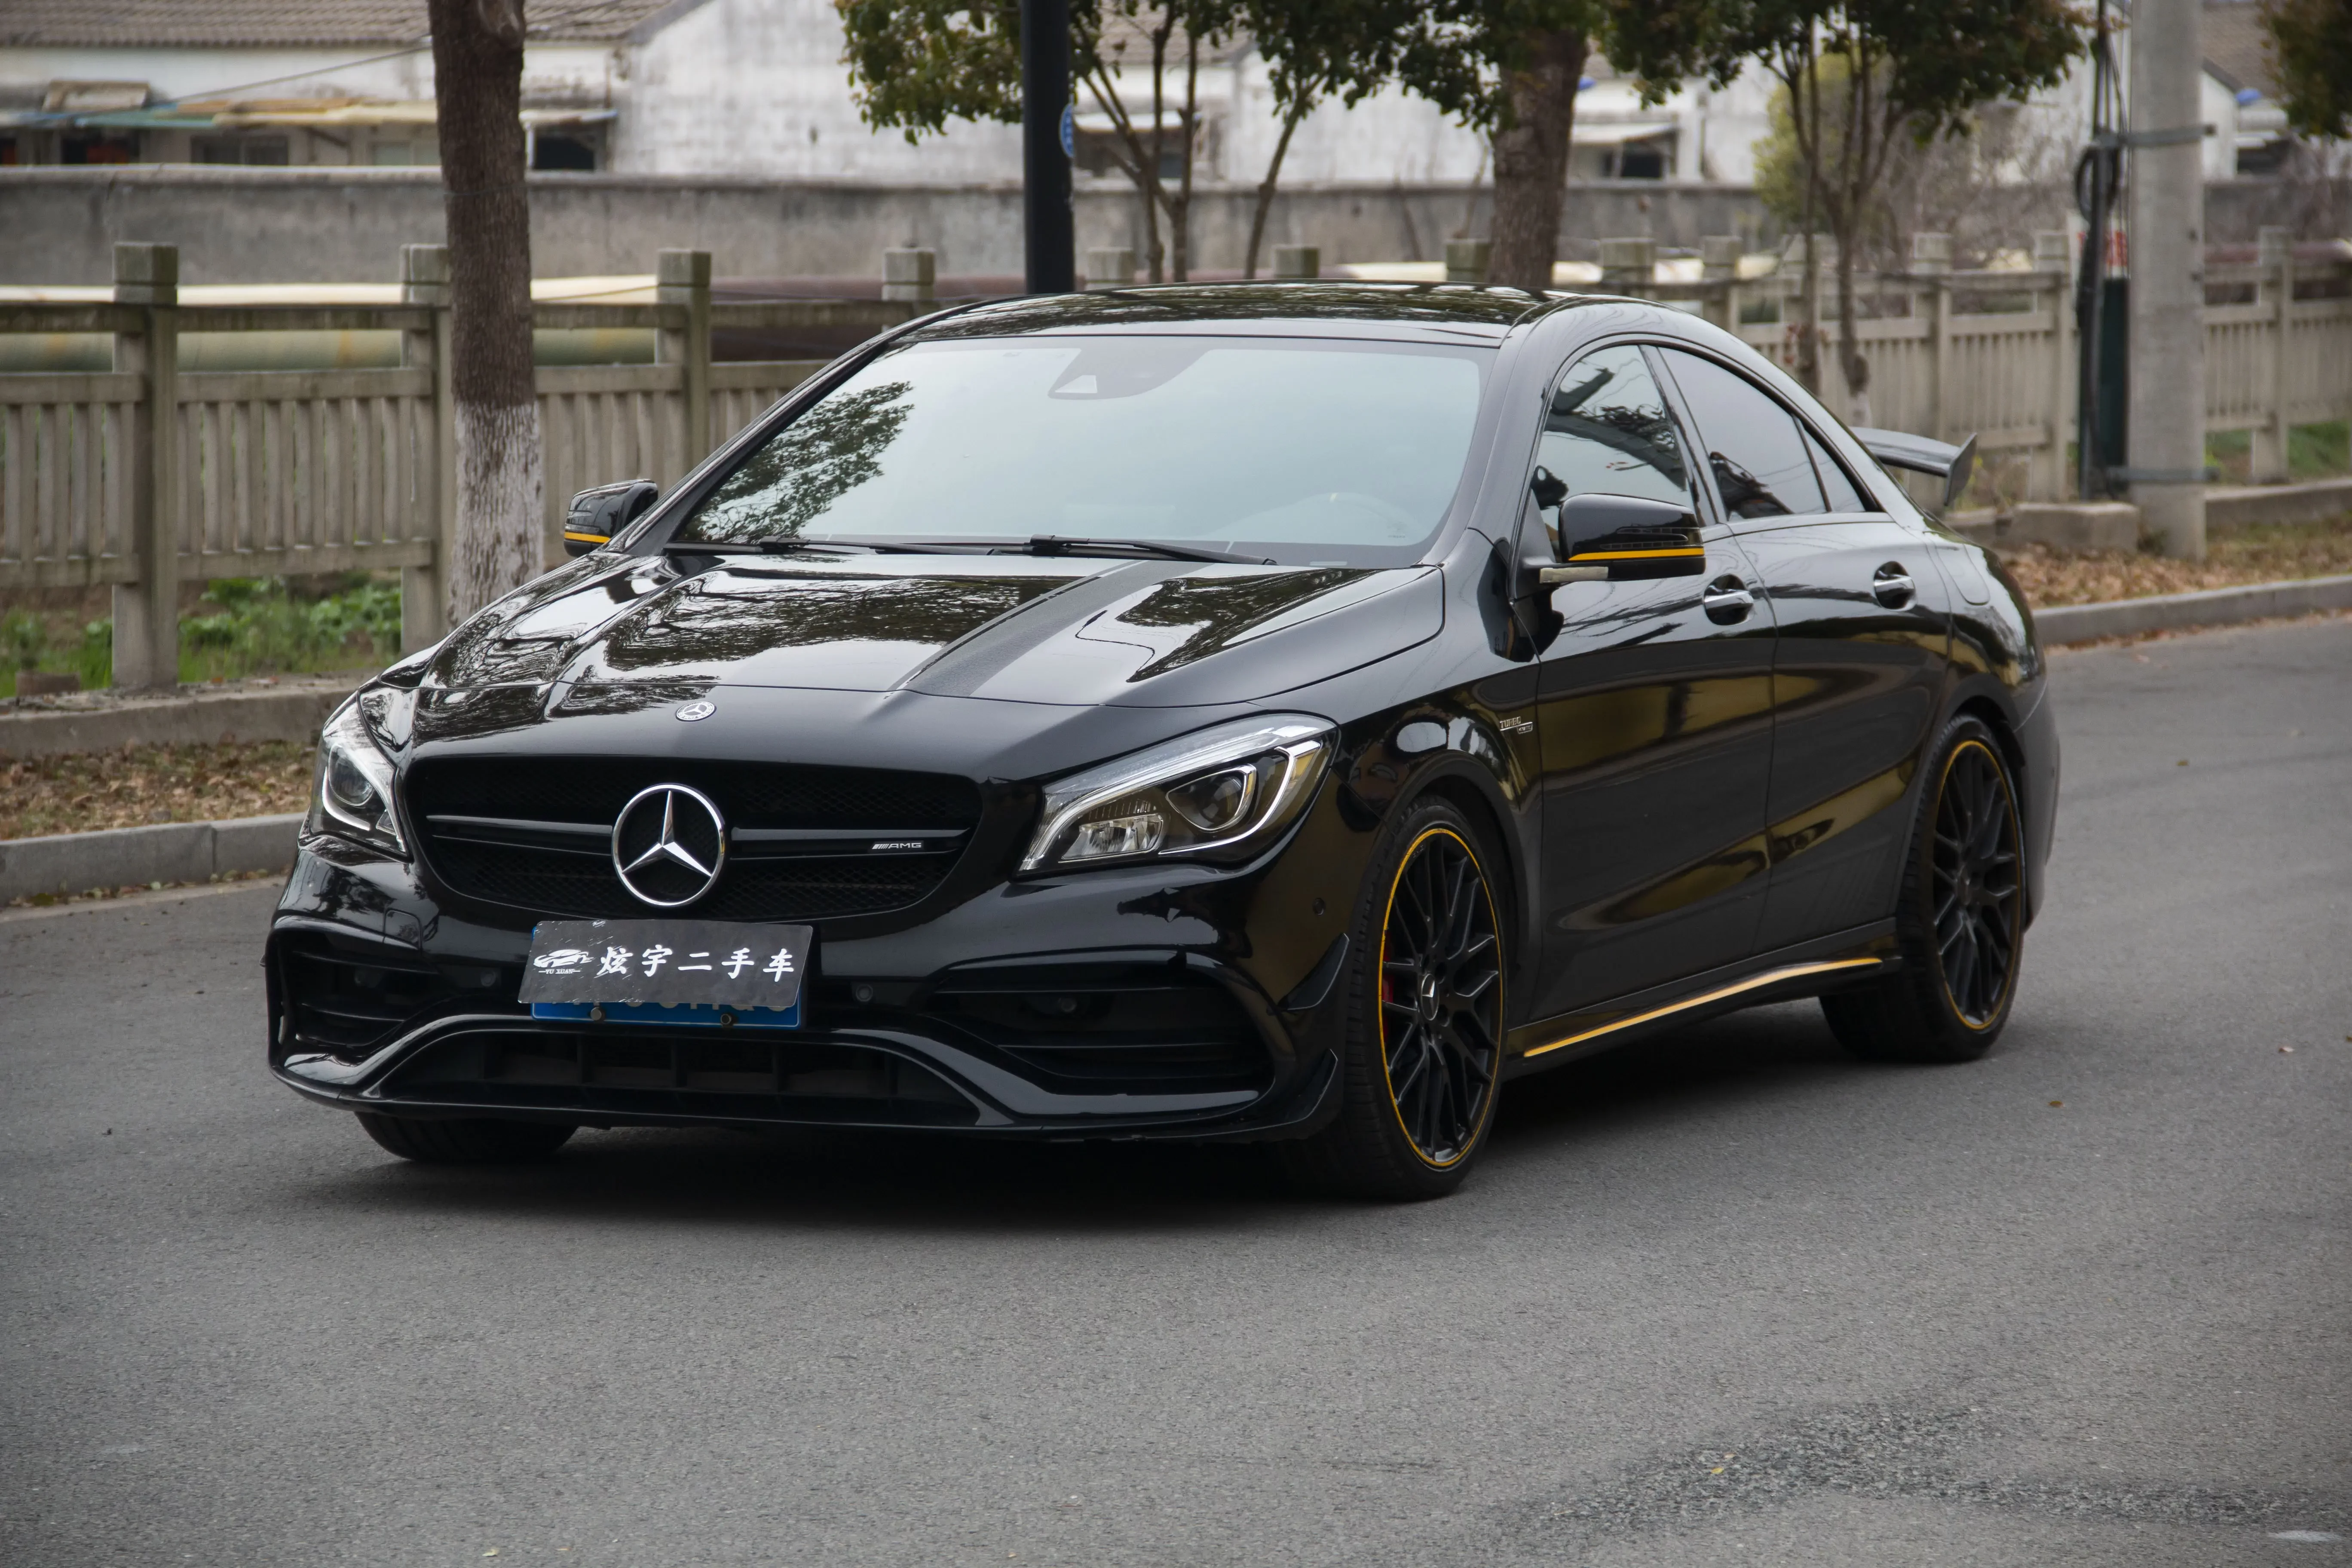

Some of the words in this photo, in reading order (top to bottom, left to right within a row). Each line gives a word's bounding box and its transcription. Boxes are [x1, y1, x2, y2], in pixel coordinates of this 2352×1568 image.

[597, 944, 794, 982] 炫宇二手车
